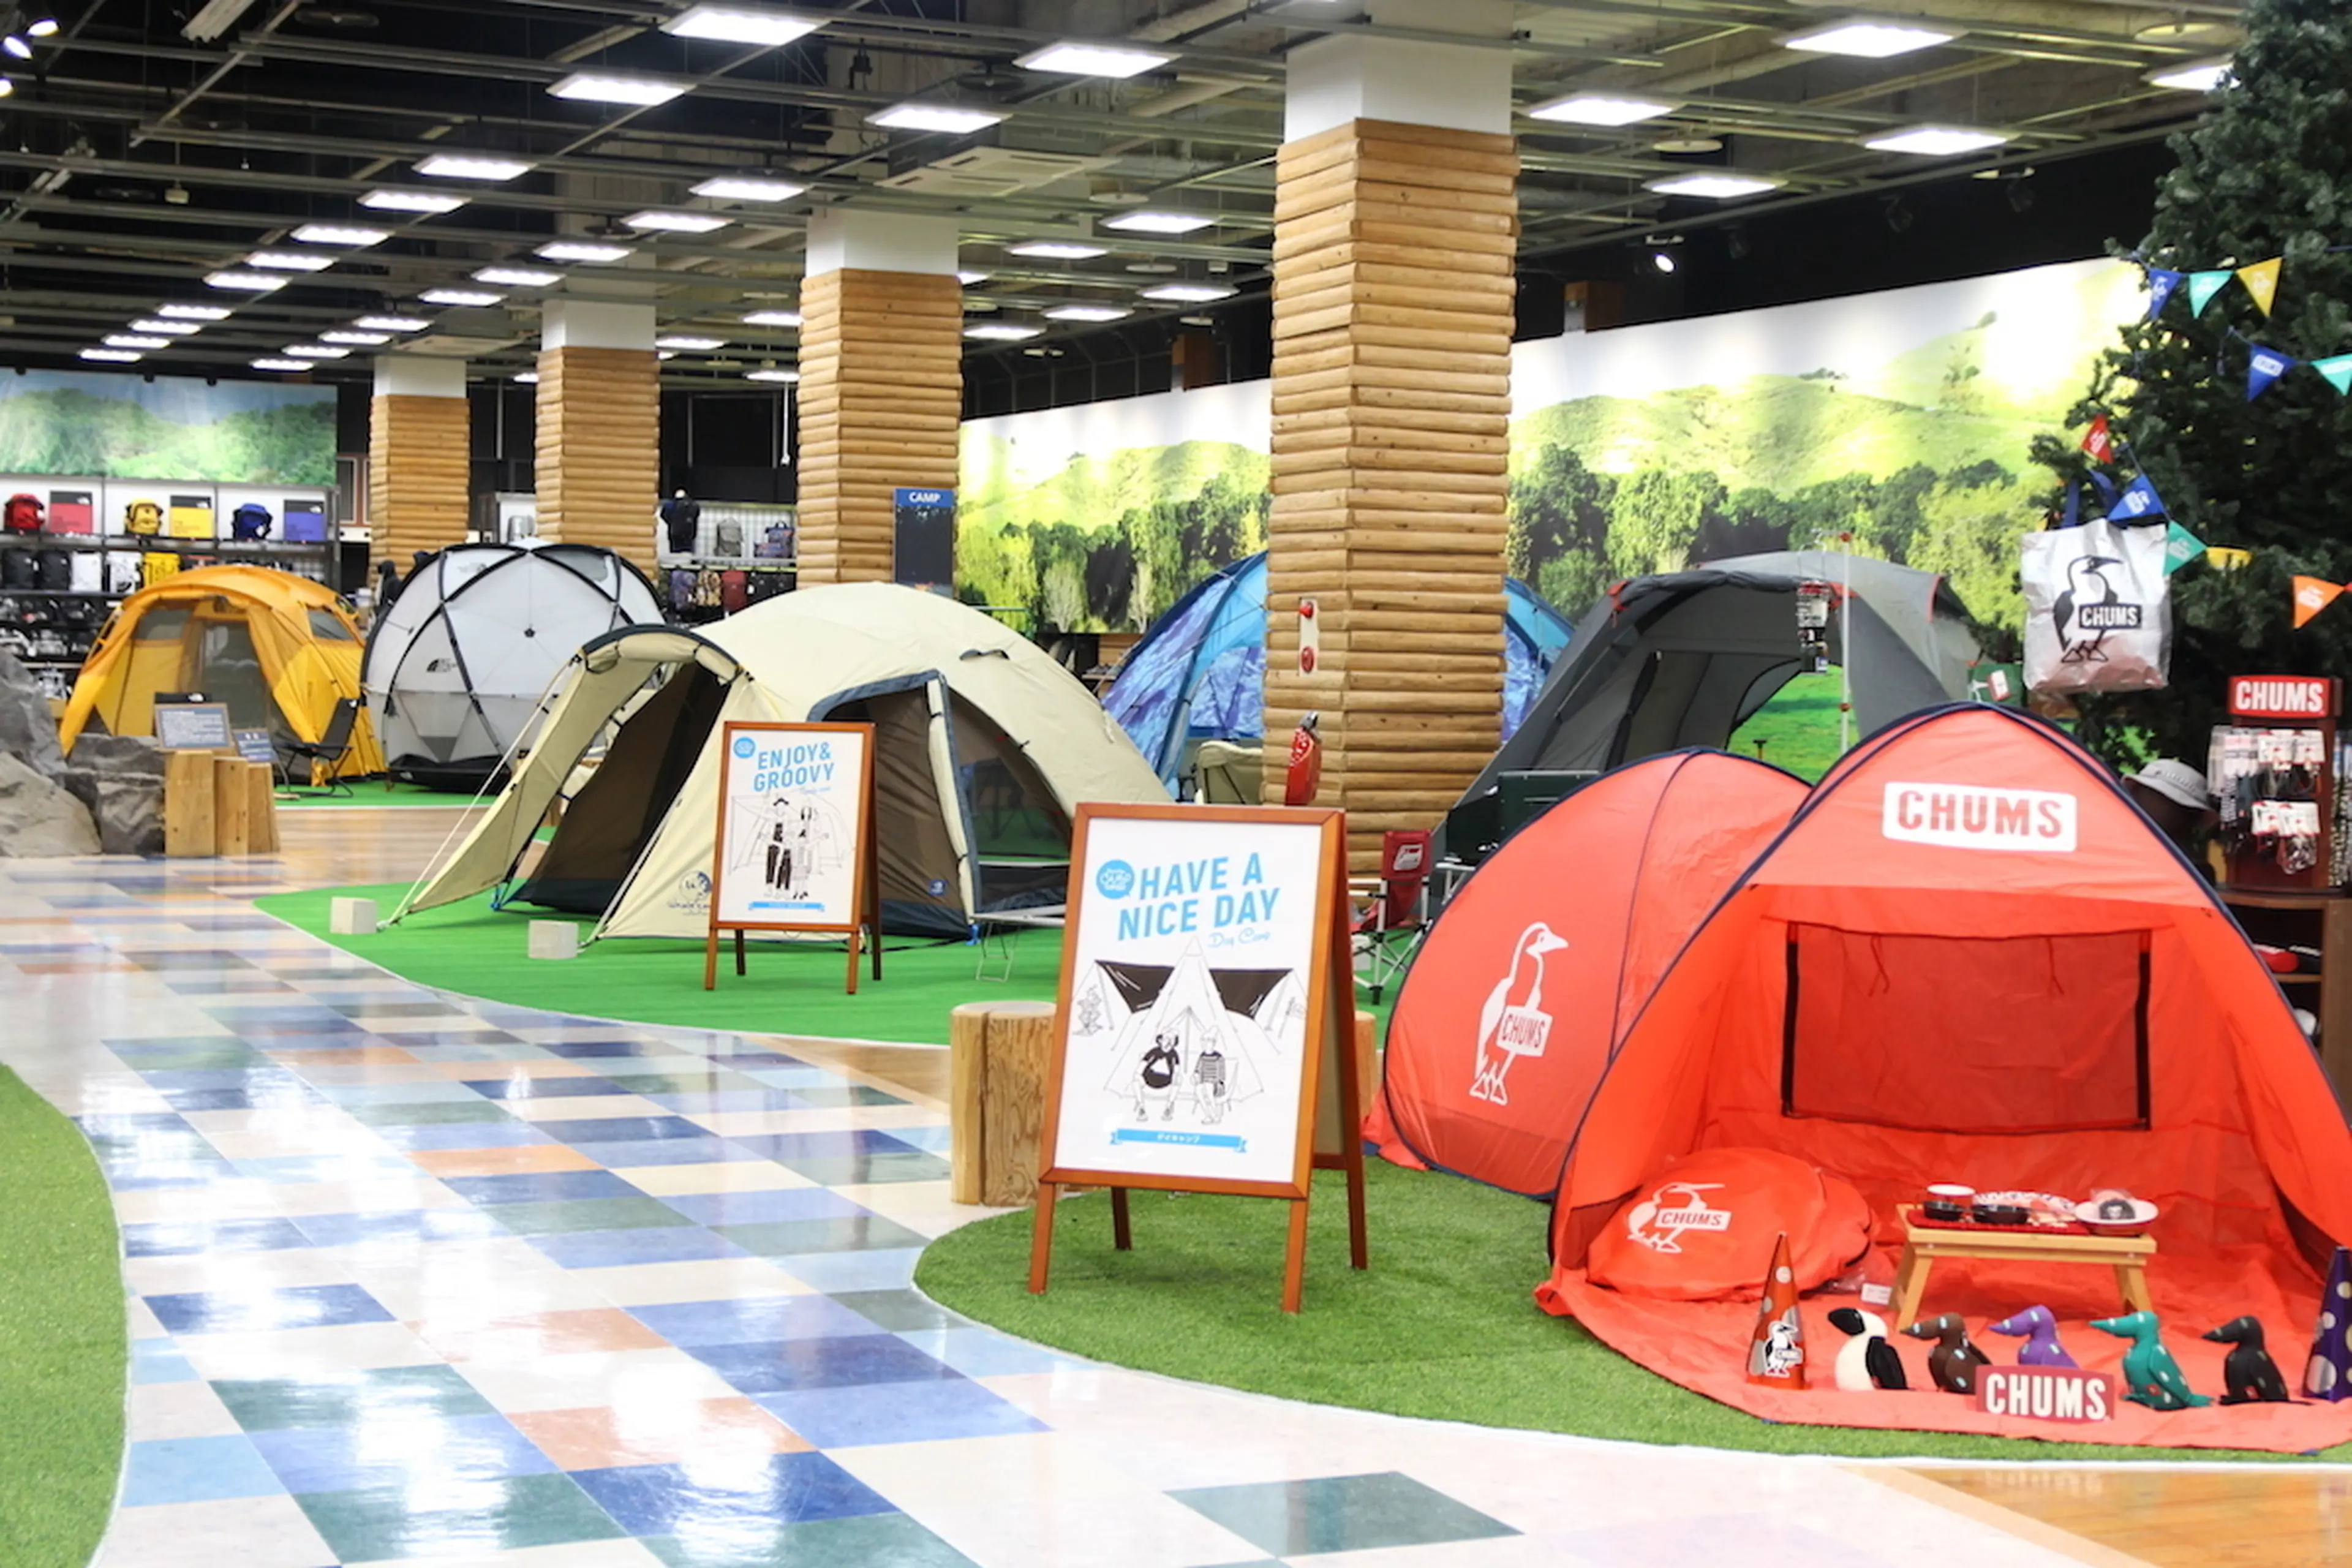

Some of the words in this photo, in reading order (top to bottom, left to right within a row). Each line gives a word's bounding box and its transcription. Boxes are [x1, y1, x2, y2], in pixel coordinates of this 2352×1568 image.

[908, 492, 941, 503] CAMP
[2081, 606, 2137, 627] CHUMS
[2236, 680, 2323, 712] CHUMS
[753, 763, 834, 792] GROOVY
[1898, 790, 2062, 839] CHUMS
[1139, 856, 1229, 900] HAVE
[1242, 852, 1263, 886] A
[1118, 899, 1199, 941] NICE
[1215, 887, 1280, 928] DAY
[1502, 1014, 1545, 1048] CHUMS
[1661, 1212, 1722, 1226] CHUMS
[1986, 1373, 2106, 1420] CHUMS
